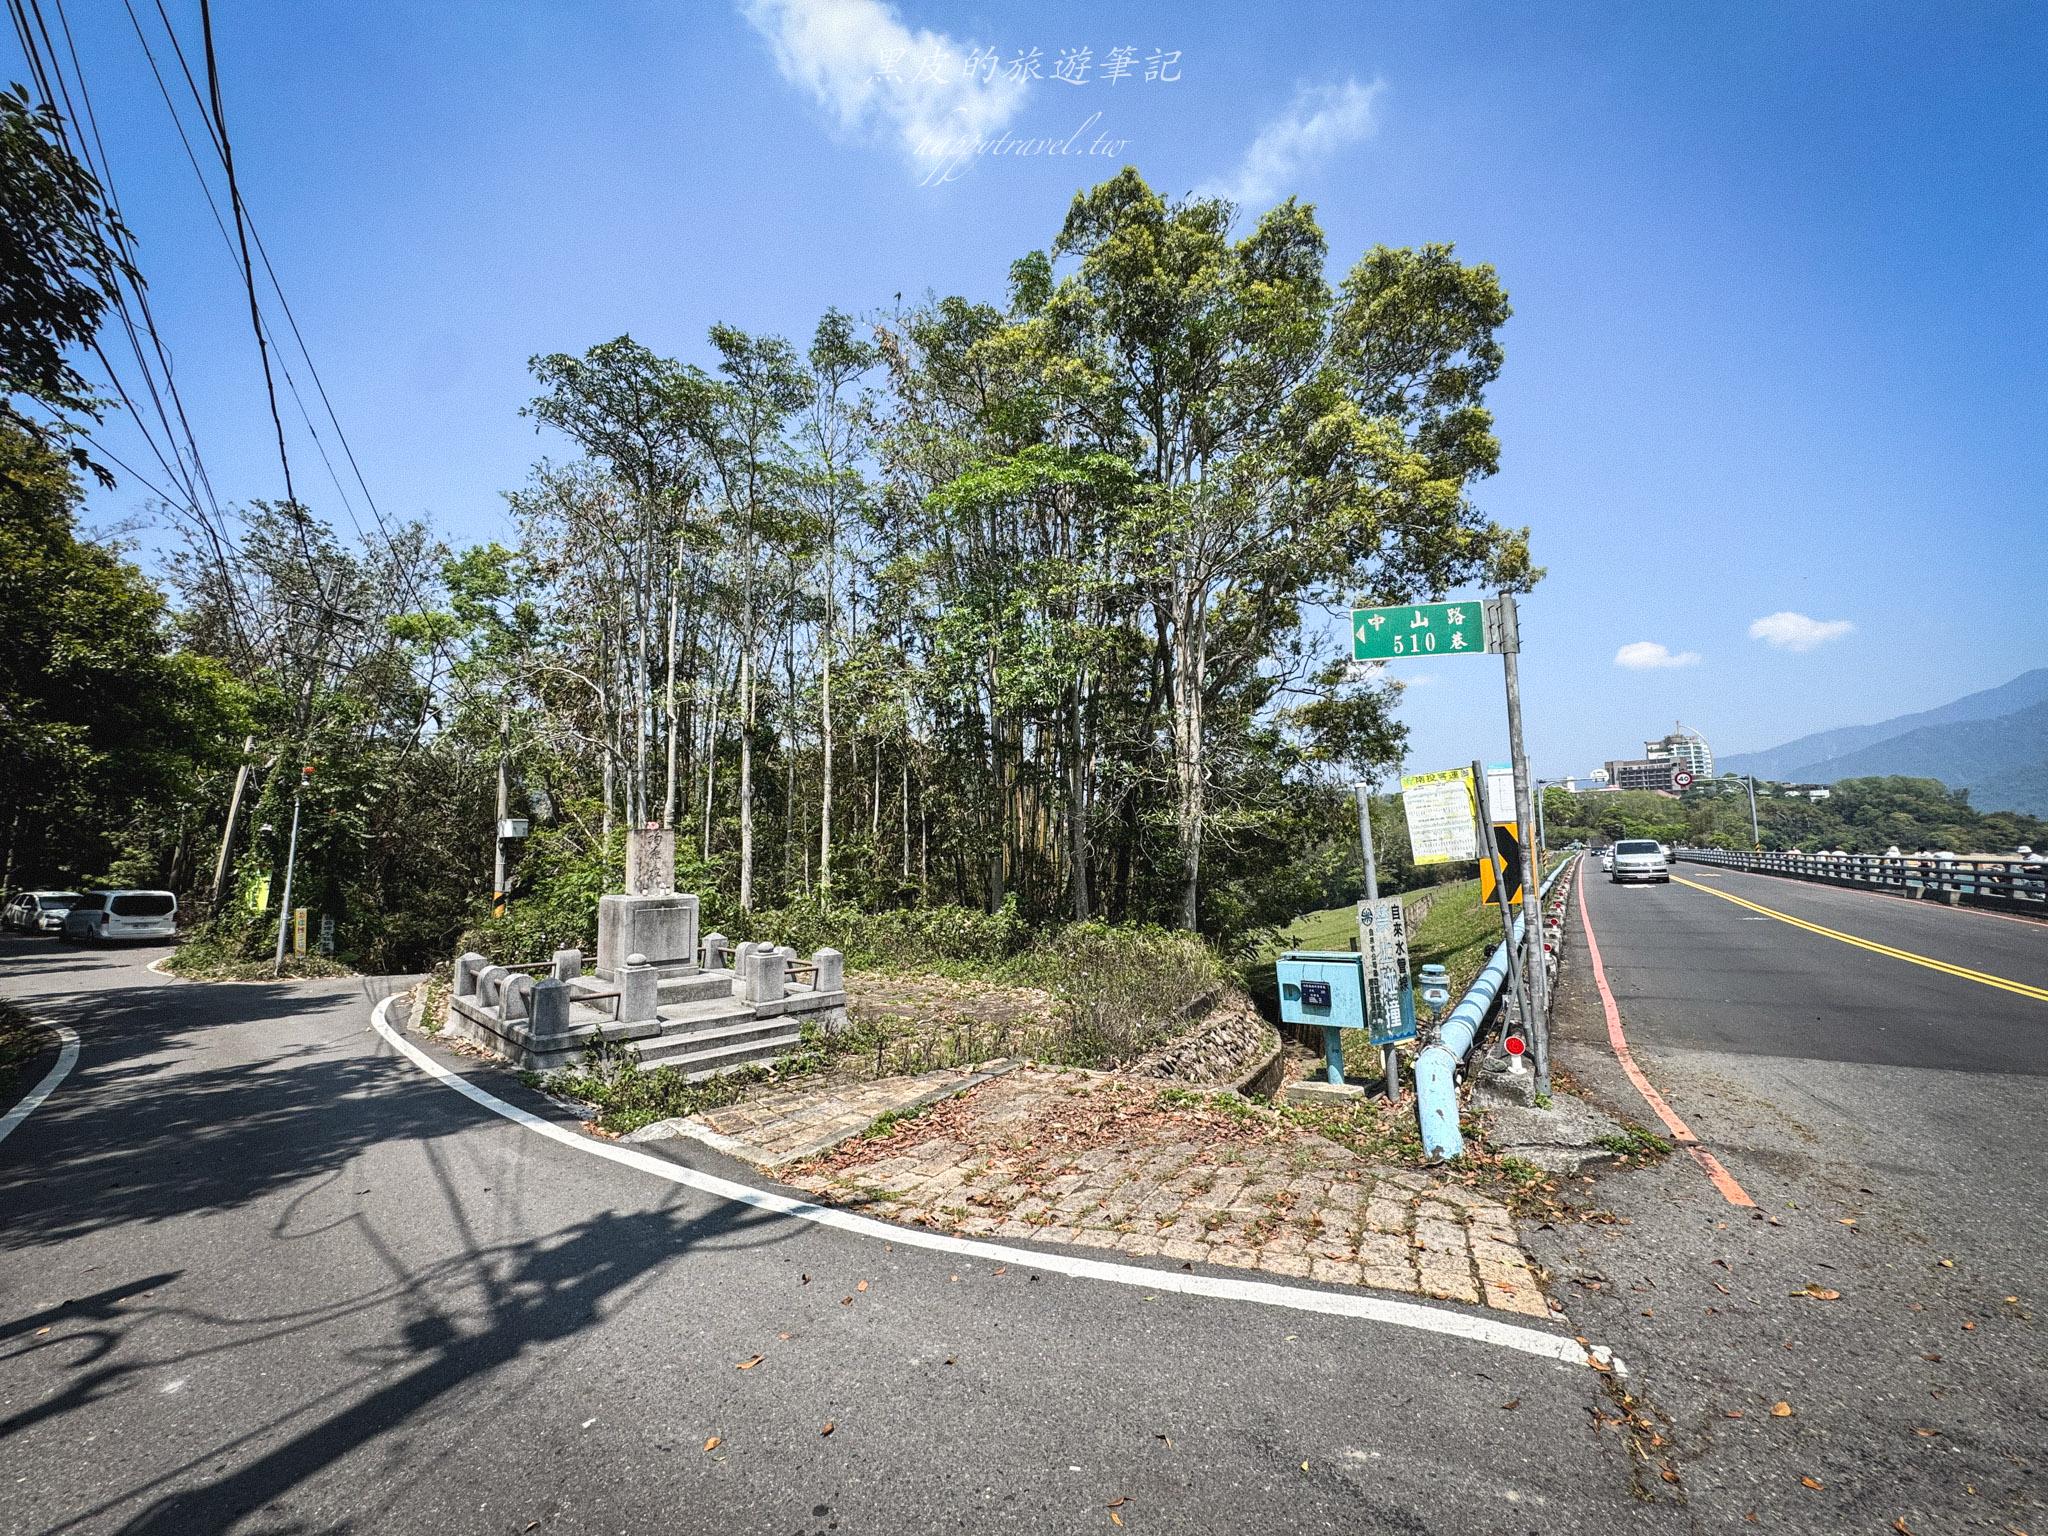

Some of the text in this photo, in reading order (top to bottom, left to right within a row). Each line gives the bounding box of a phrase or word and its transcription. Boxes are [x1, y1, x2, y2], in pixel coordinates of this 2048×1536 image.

[1367, 606, 1467, 632] 中山路
[1391, 904, 1409, 992] 自來水管線
